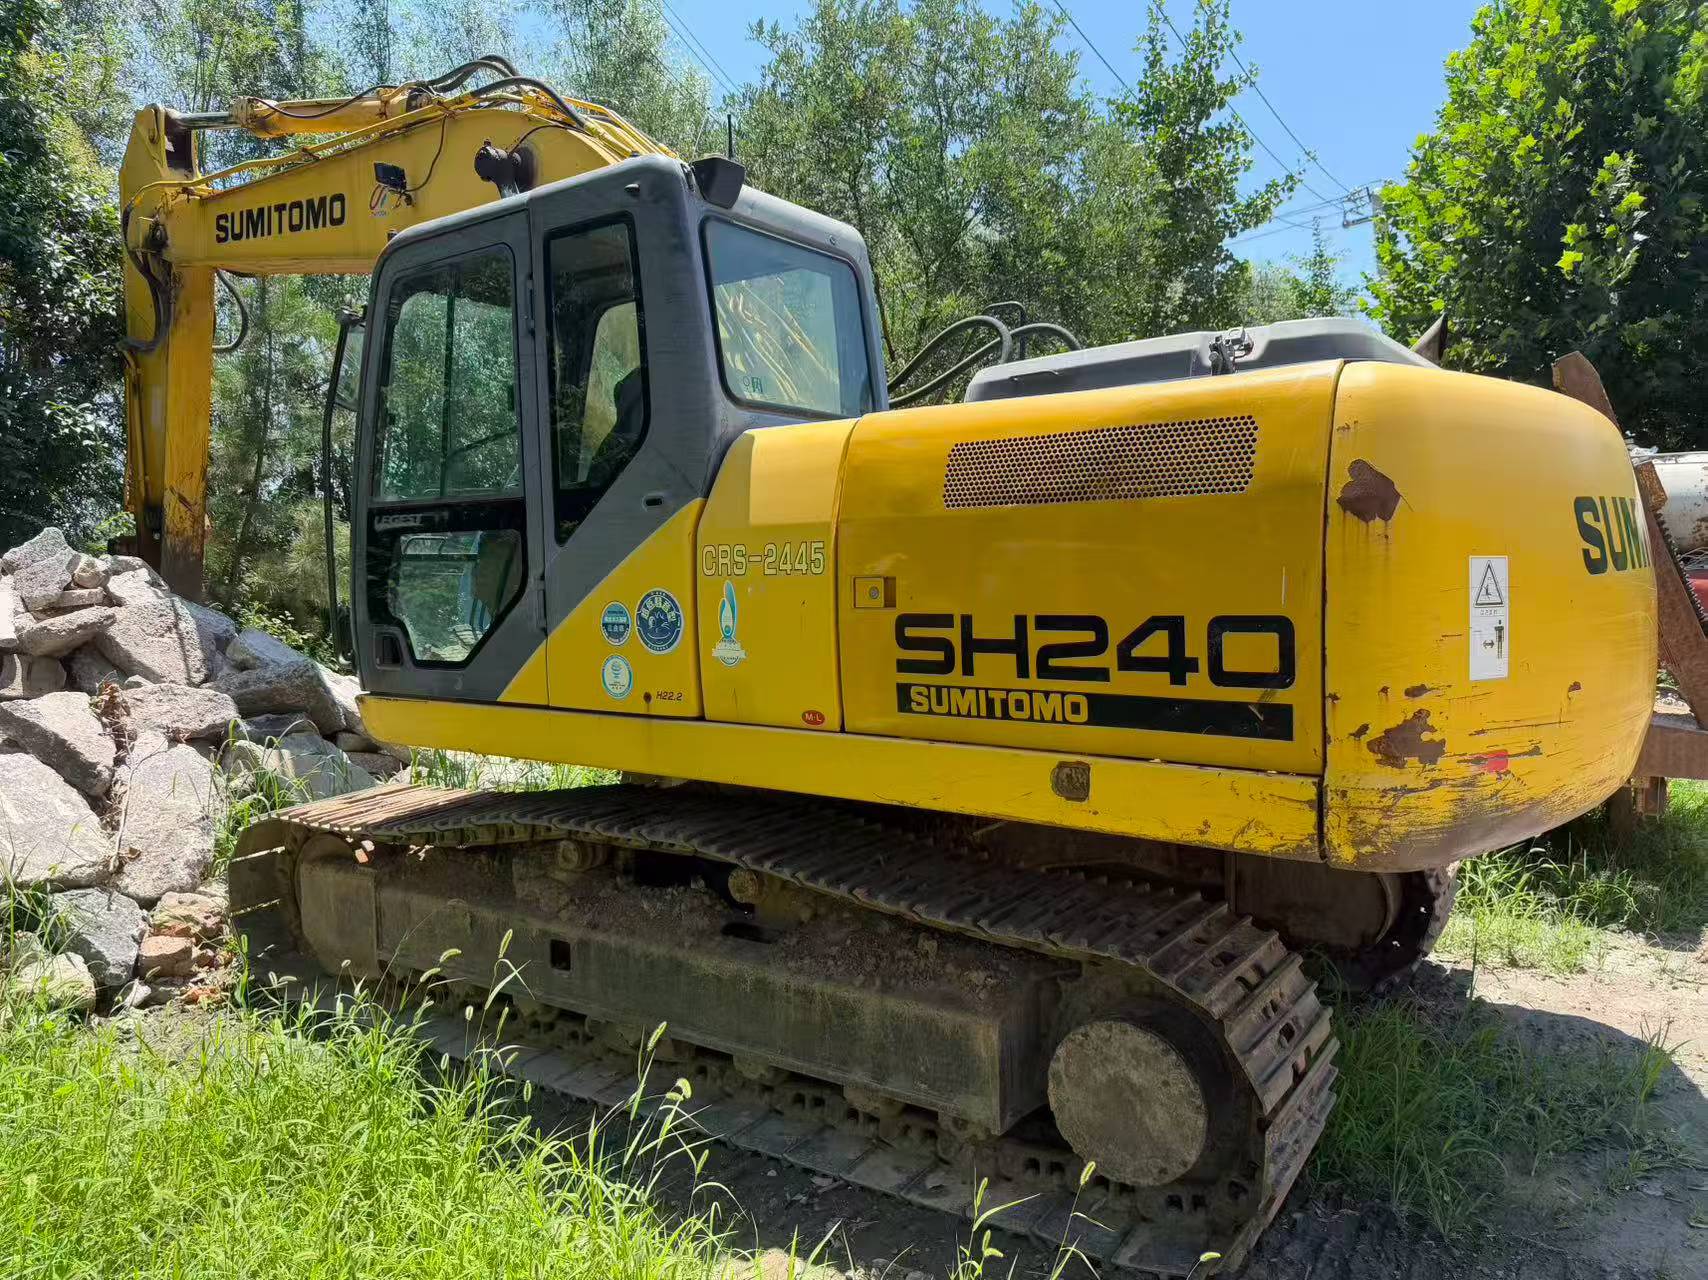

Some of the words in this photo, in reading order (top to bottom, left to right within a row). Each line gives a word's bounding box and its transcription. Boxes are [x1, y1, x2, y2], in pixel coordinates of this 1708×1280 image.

[215, 192, 346, 244] SUMITOMO
[701, 540, 825, 577] CRS-2445
[895, 613, 1296, 690] SH240
[655, 690, 683, 702] H22.2
[910, 685, 1089, 724] SUMITOMO
